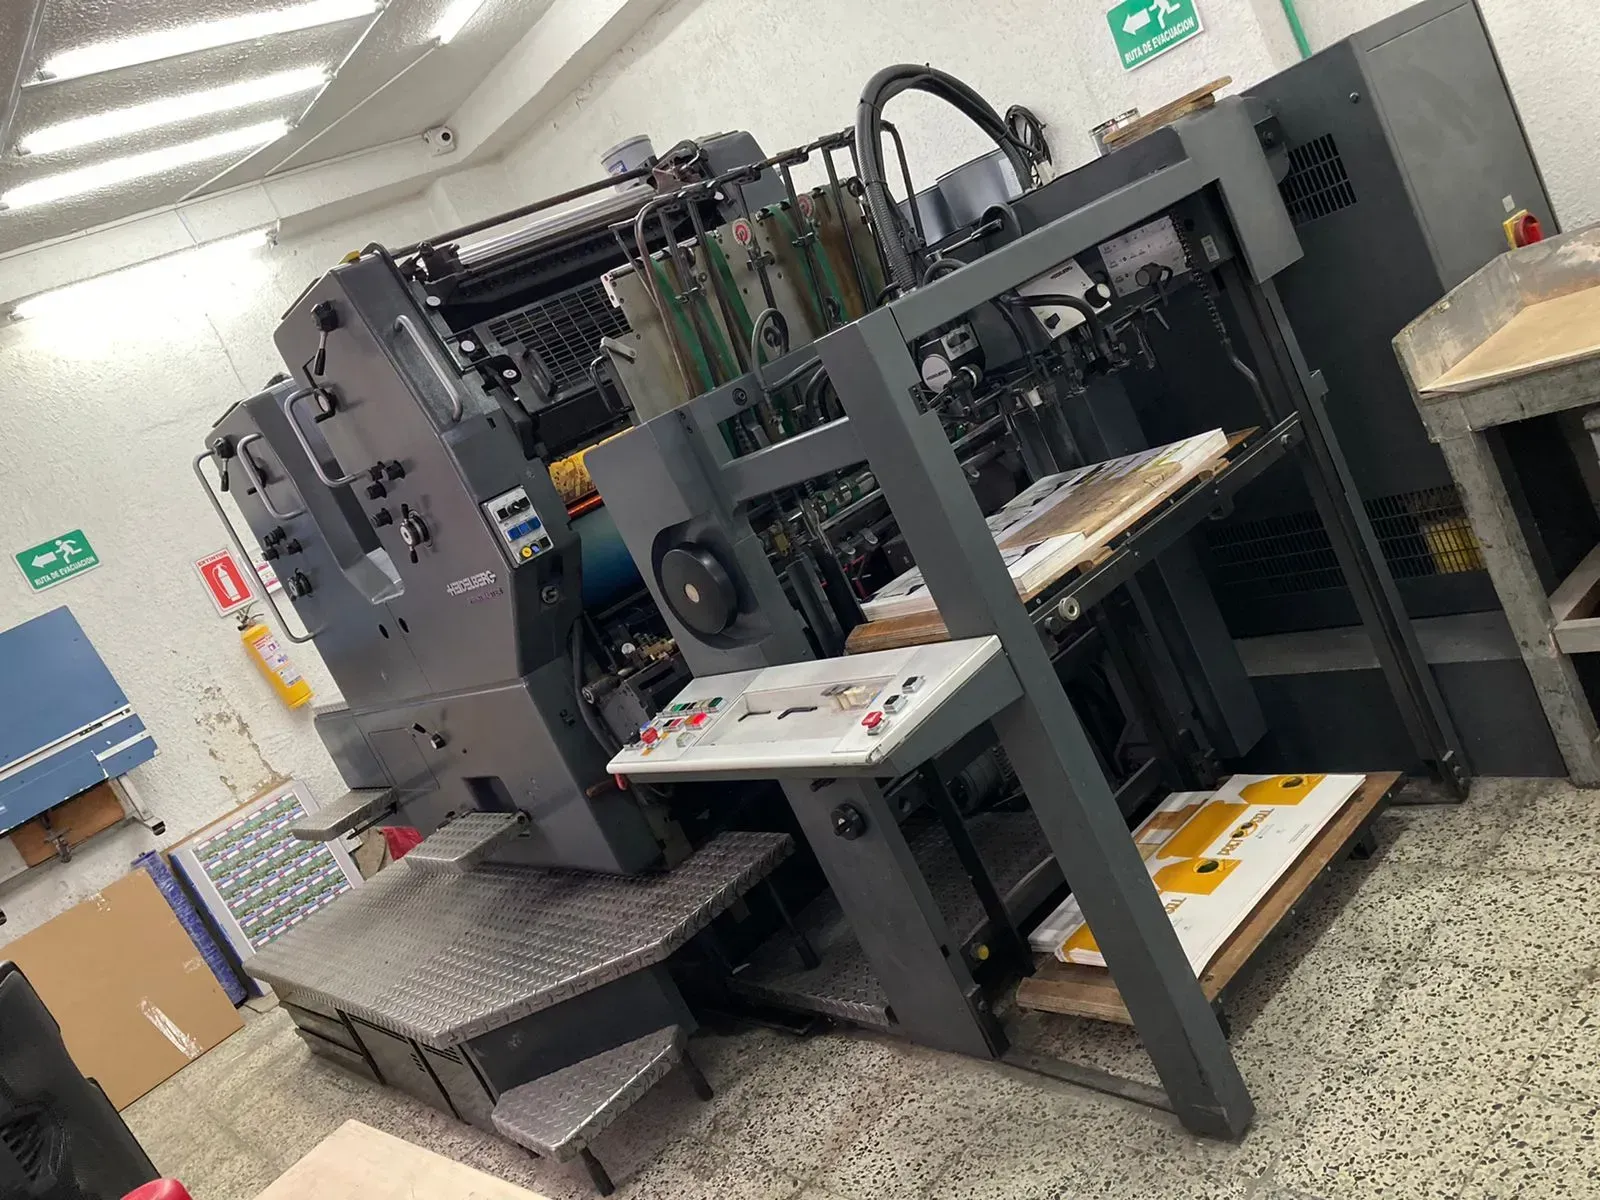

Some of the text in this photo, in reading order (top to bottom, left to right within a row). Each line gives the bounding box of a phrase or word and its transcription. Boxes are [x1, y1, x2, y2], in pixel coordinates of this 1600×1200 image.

[1124, 16, 1195, 64] RUTA DE EVACUACION
[34, 574, 51, 586] RUTA
[50, 570, 60, 580] DE
